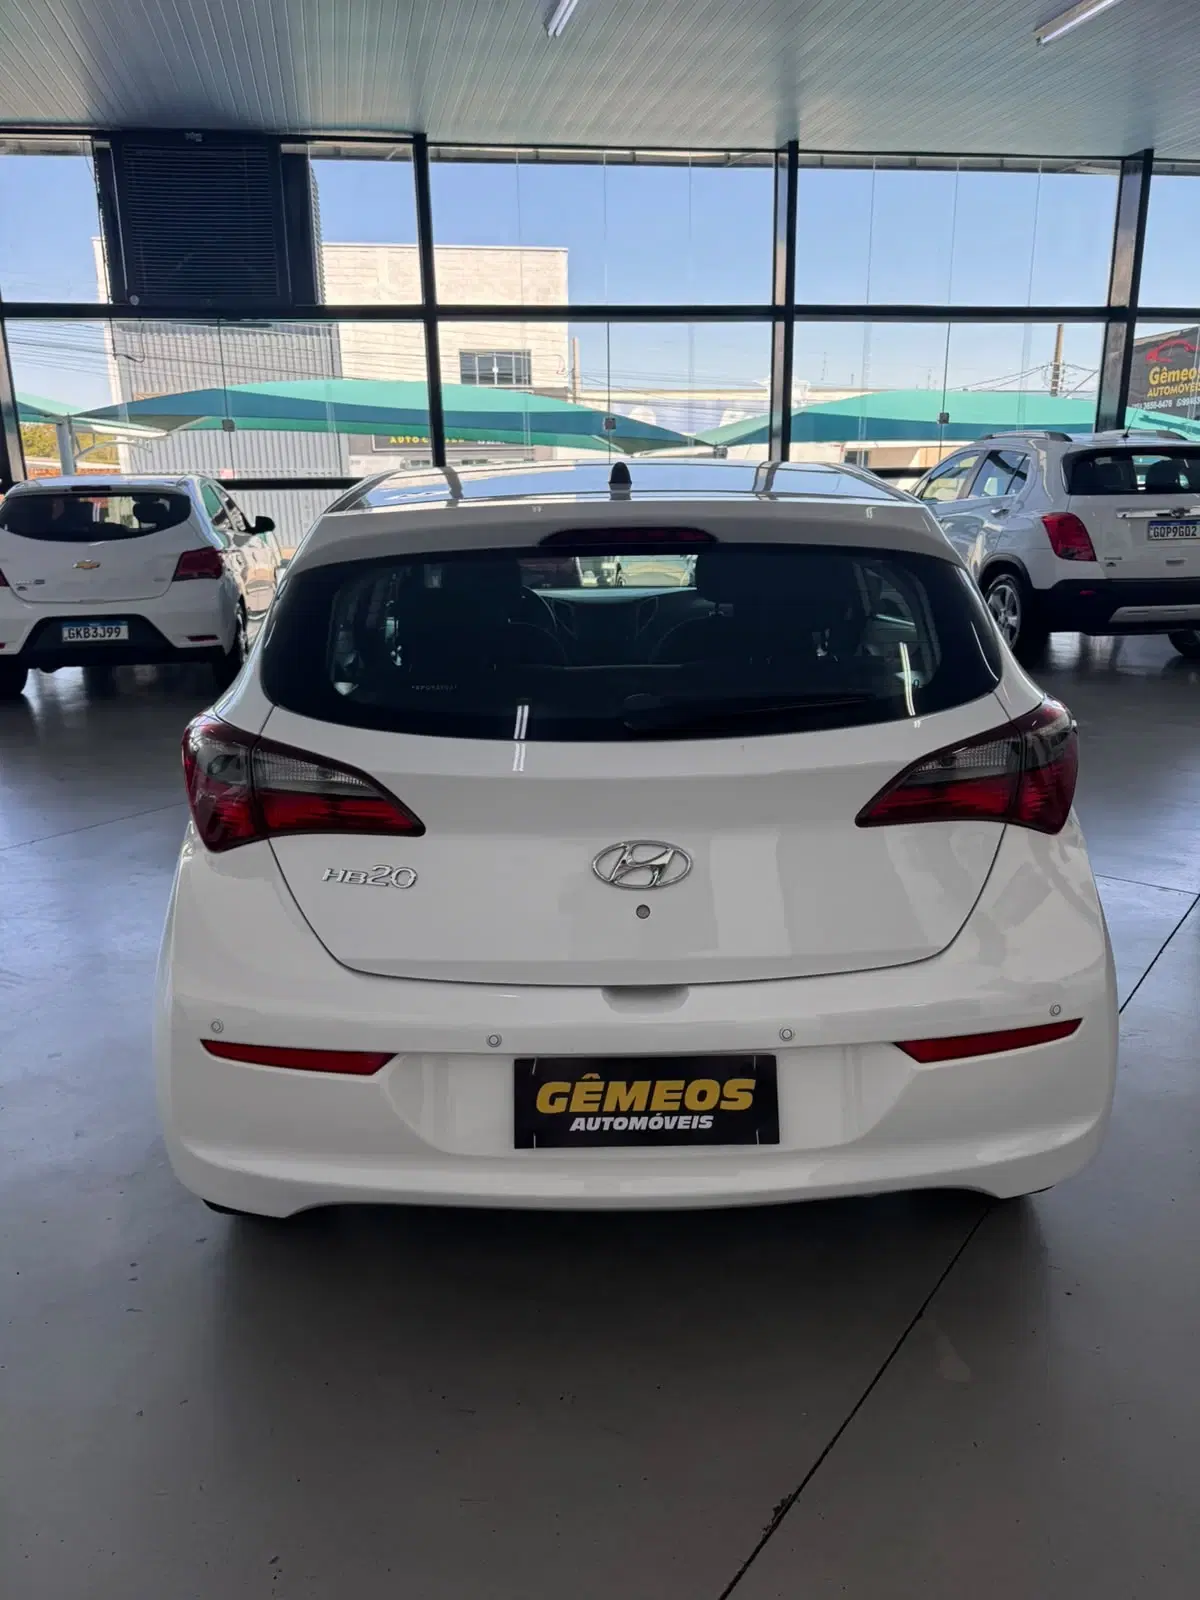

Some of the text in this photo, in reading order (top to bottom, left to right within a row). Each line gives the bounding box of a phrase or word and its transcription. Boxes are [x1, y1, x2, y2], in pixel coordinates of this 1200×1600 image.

[67, 627, 121, 639] GKB3J99
[321, 864, 418, 889] HB20
[535, 1072, 756, 1114] GÊMEOS
[569, 1112, 714, 1132] AUTOMÓVEIS
